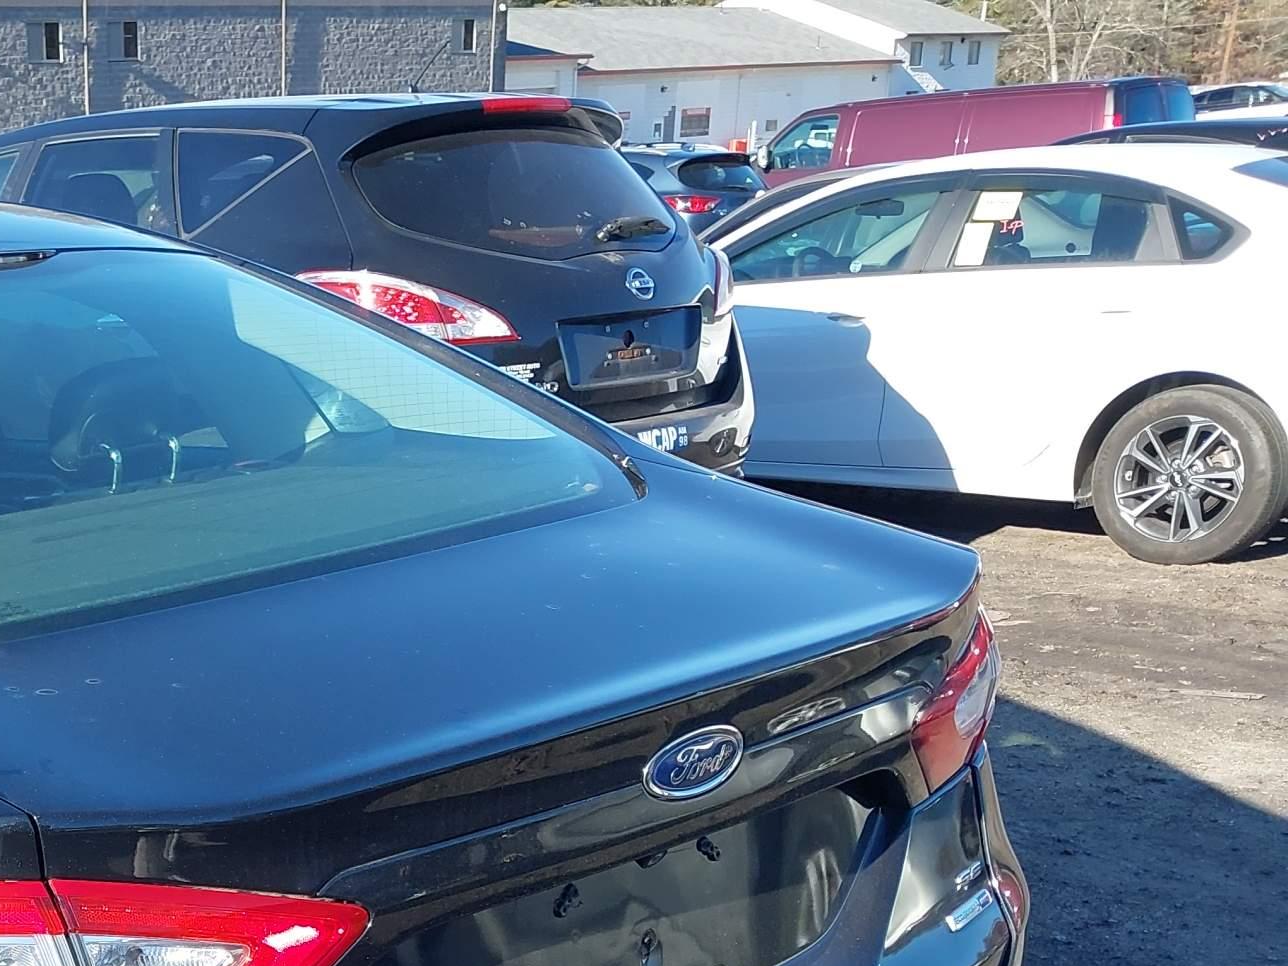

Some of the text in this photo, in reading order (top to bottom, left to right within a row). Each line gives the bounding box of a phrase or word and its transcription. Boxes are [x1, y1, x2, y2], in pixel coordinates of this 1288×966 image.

[637, 426, 677, 452] WCAP
[679, 436, 688, 447] 98
[670, 739, 733, 785] Ford
